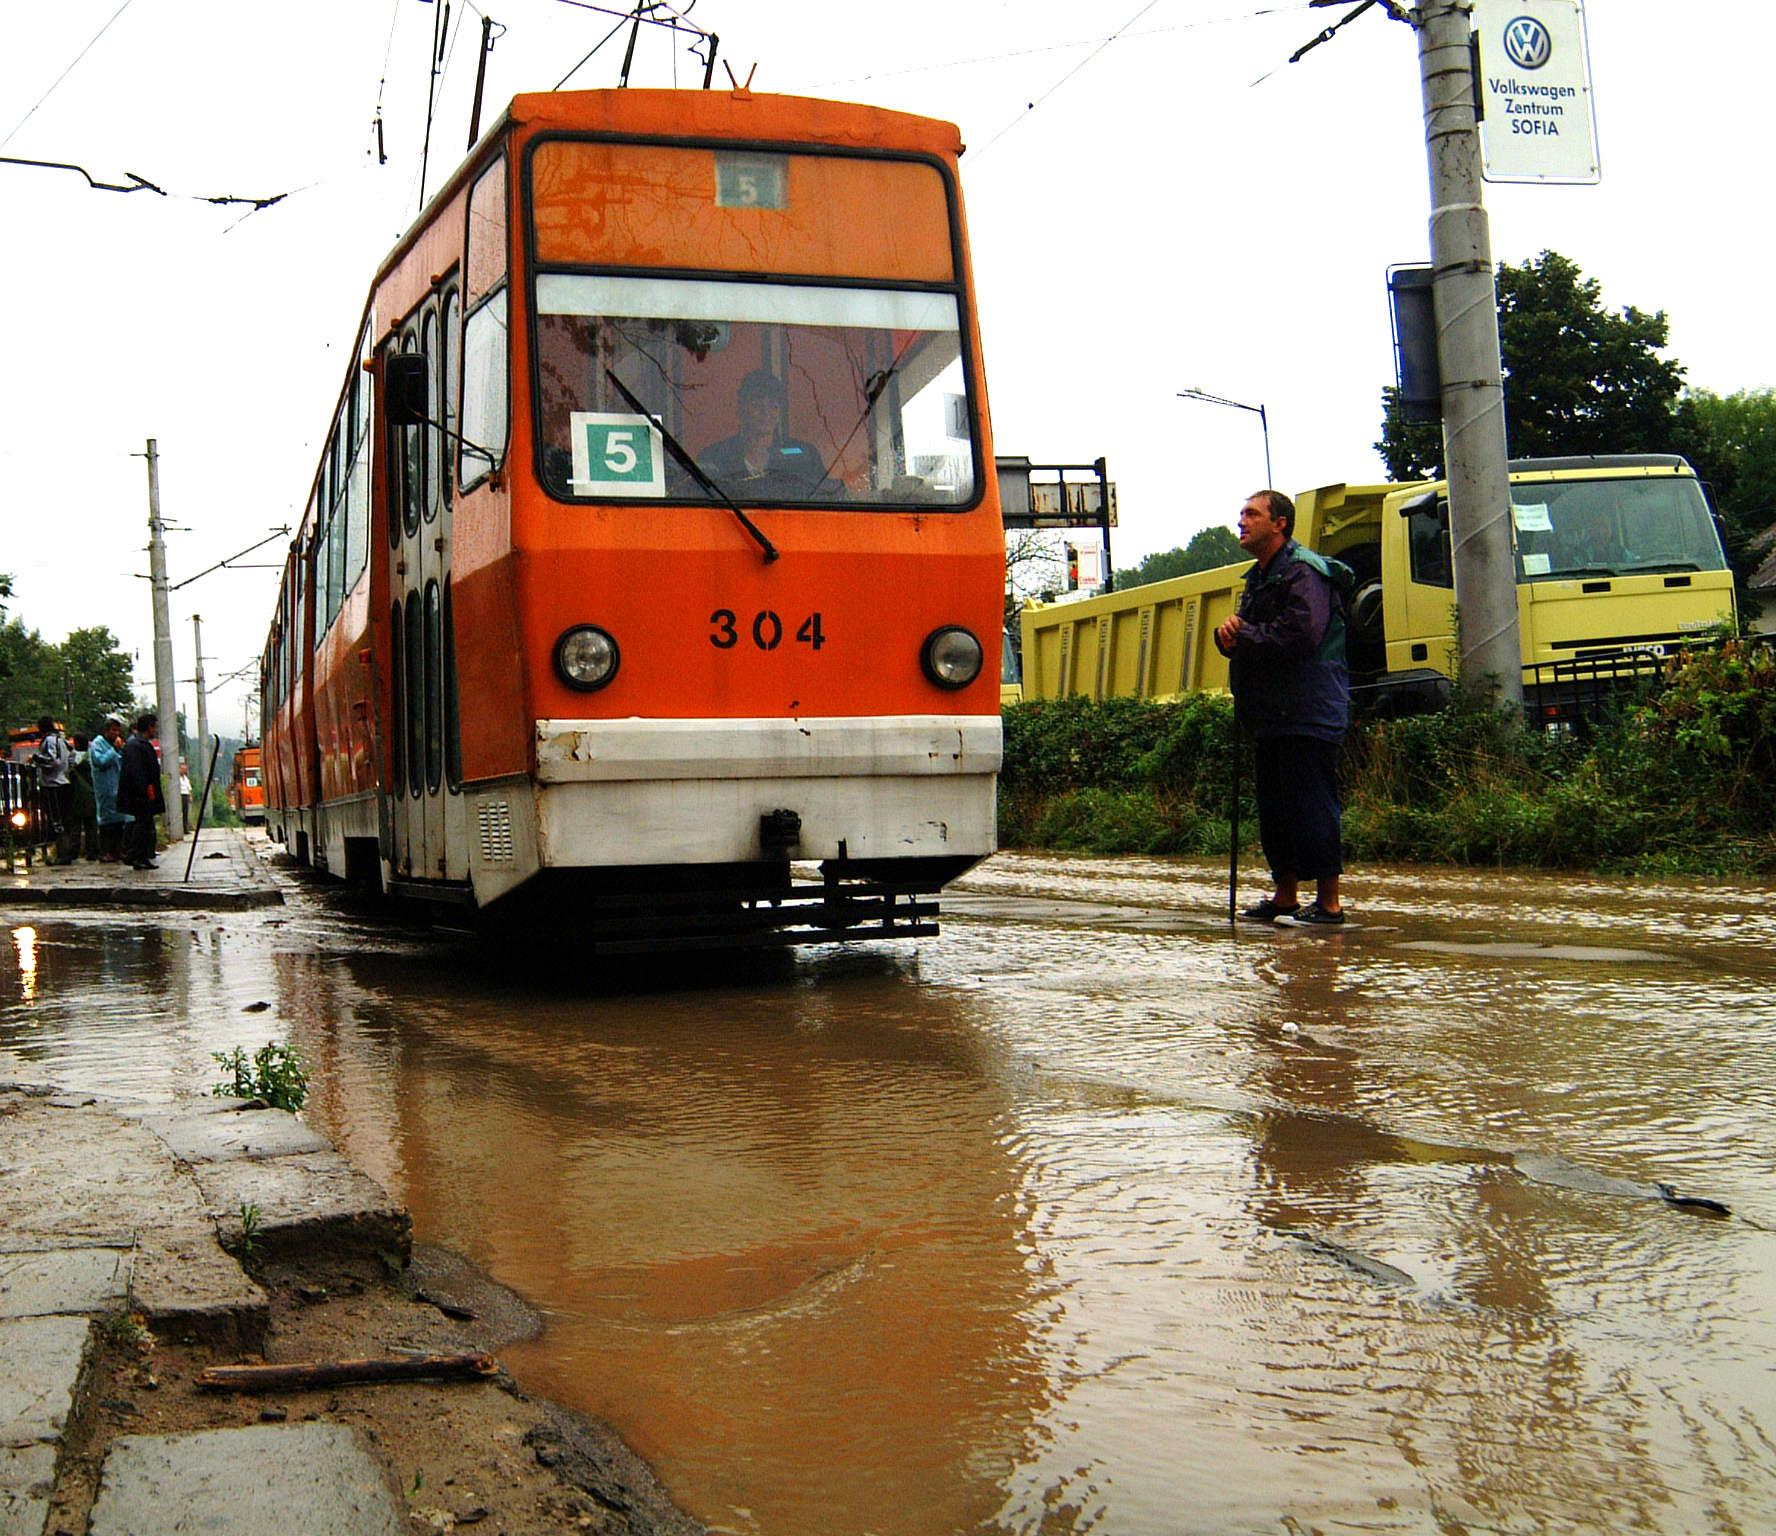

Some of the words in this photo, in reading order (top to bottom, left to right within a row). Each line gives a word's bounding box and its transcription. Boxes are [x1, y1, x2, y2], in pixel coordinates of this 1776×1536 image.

[1489, 78, 1576, 100] Volkswagen
[1504, 98, 1564, 116] Zentrum
[1511, 119, 1560, 136] SOFIA
[738, 175, 758, 204] 5
[604, 431, 637, 474] 5
[709, 608, 826, 651] 304
